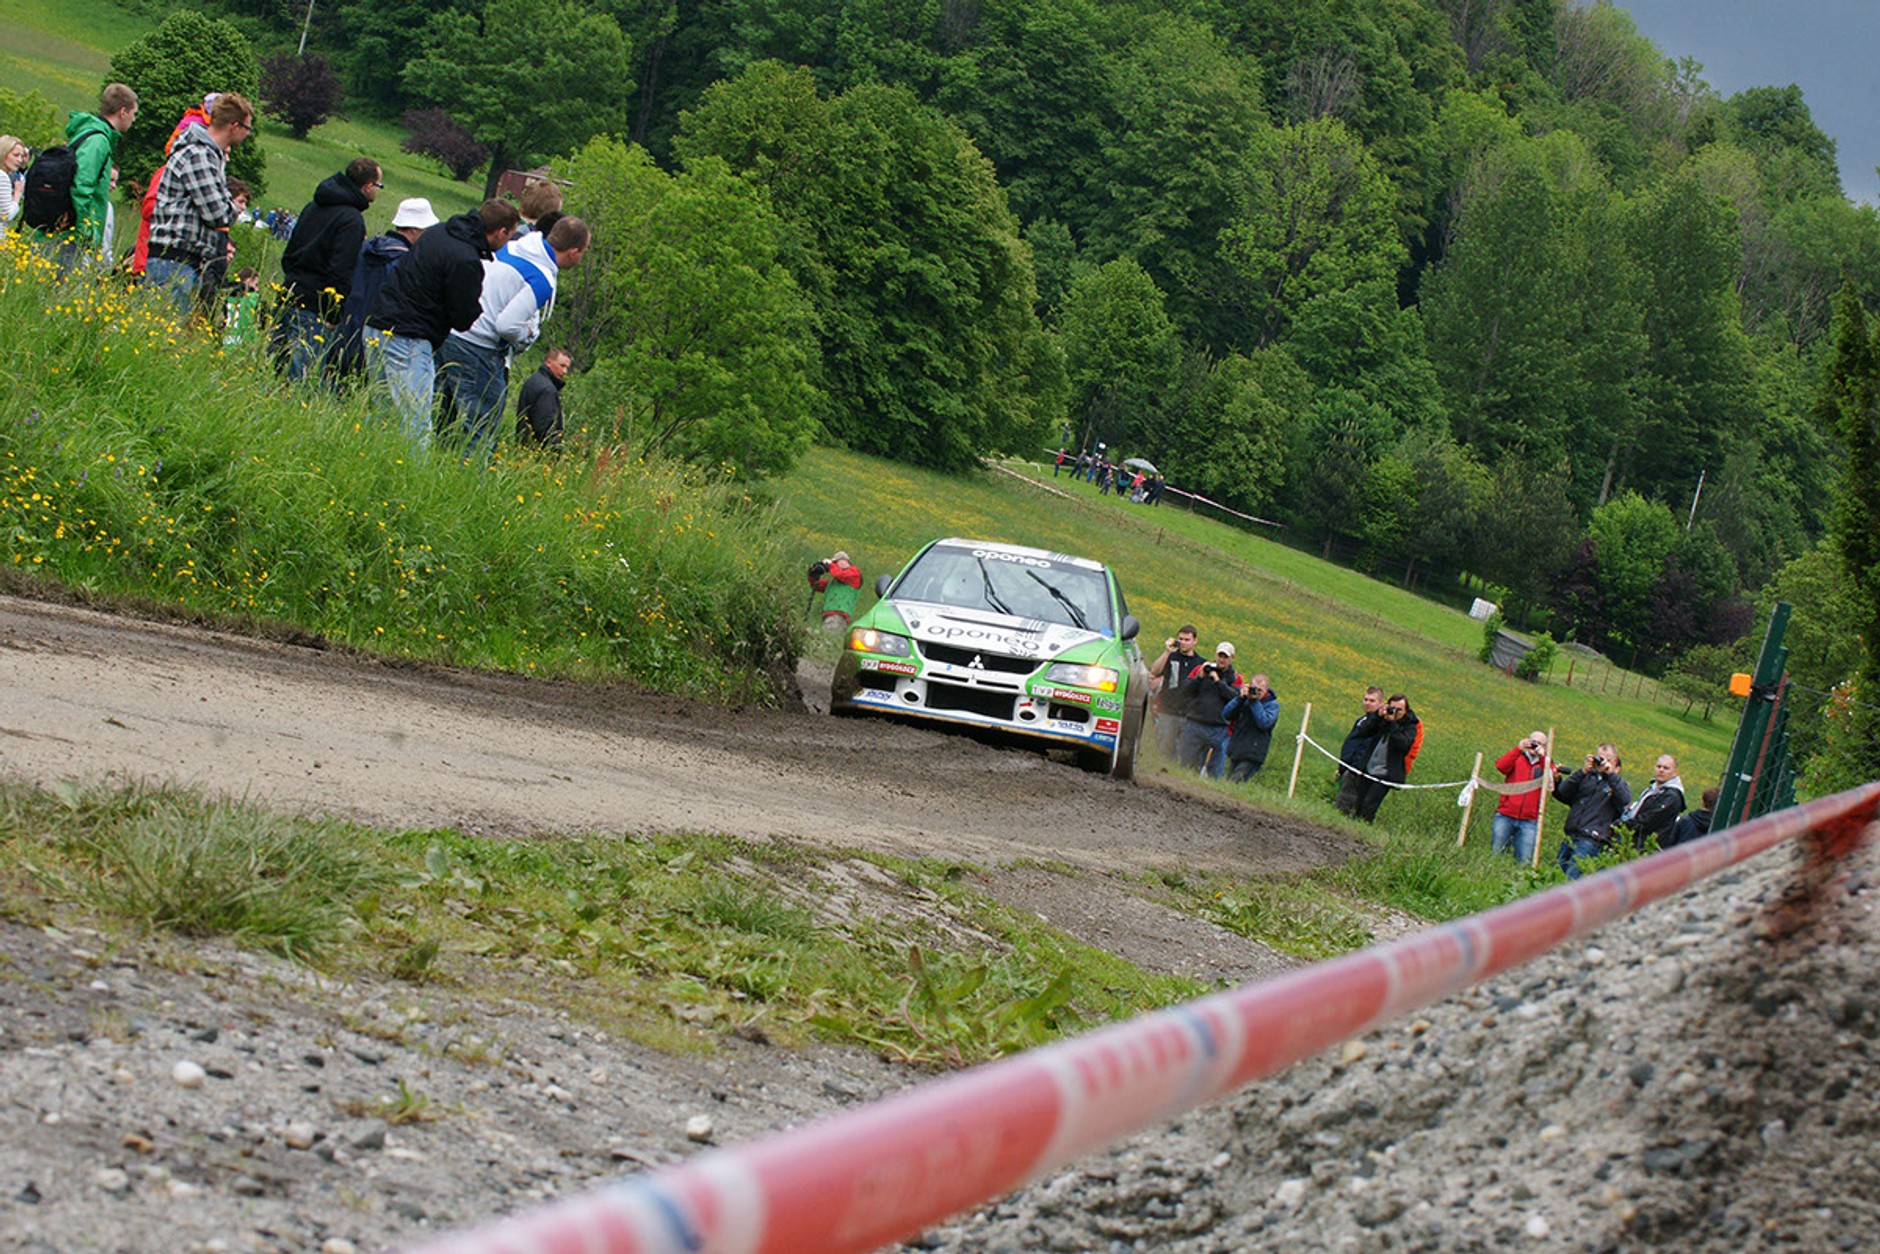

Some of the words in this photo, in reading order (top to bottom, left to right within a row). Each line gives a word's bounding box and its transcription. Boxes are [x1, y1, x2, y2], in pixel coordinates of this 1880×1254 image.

[972, 549, 1051, 569] oponeo
[927, 625, 1040, 652] oponeo
[1033, 686, 1053, 696] TVP
